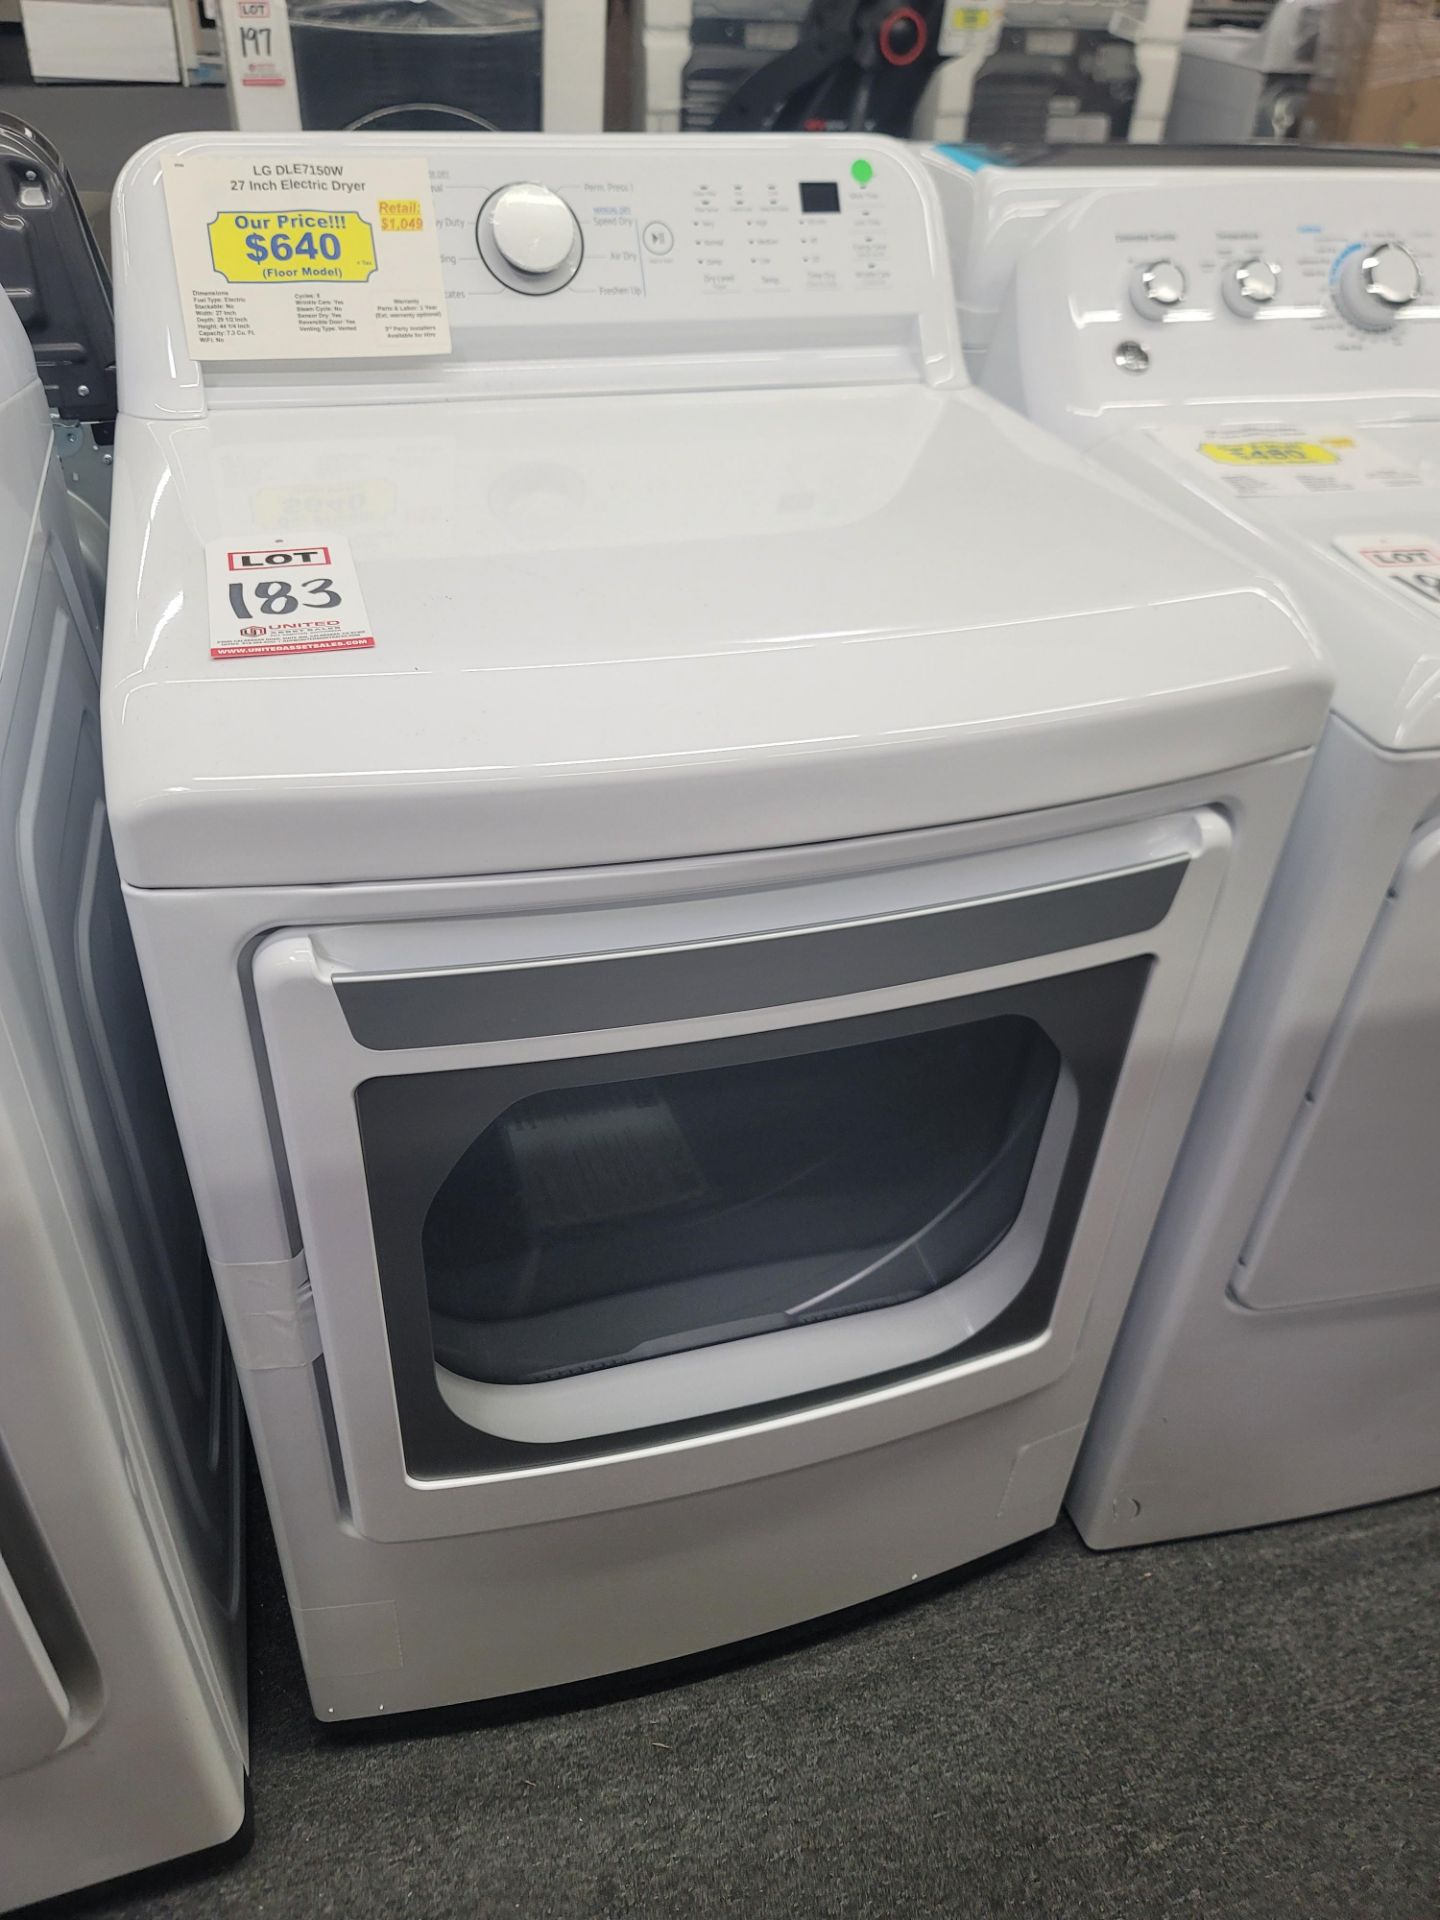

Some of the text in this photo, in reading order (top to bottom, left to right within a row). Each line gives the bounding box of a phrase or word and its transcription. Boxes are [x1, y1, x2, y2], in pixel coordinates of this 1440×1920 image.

[243, 5, 265, 15] LOT
[240, 26, 271, 58] 197
[253, 163, 344, 176] LG DLE7150W
[230, 180, 366, 193] 27 Inch Electric Dryer
[378, 201, 421, 214] Retail:
[234, 213, 347, 230] Our Price!!!
[381, 217, 423, 231] $1,049
[445, 217, 465, 229] Duty
[592, 216, 633, 227] Speed Dry
[244, 231, 342, 265] $640
[262, 267, 343, 279] (Floor Model)
[241, 551, 319, 567] LOT
[1373, 552, 1431, 564] LOT
[228, 578, 343, 619] 183
[269, 620, 341, 630] UNITED
[217, 638, 368, 655] WWW.UNITEDASSETSALES.COM
